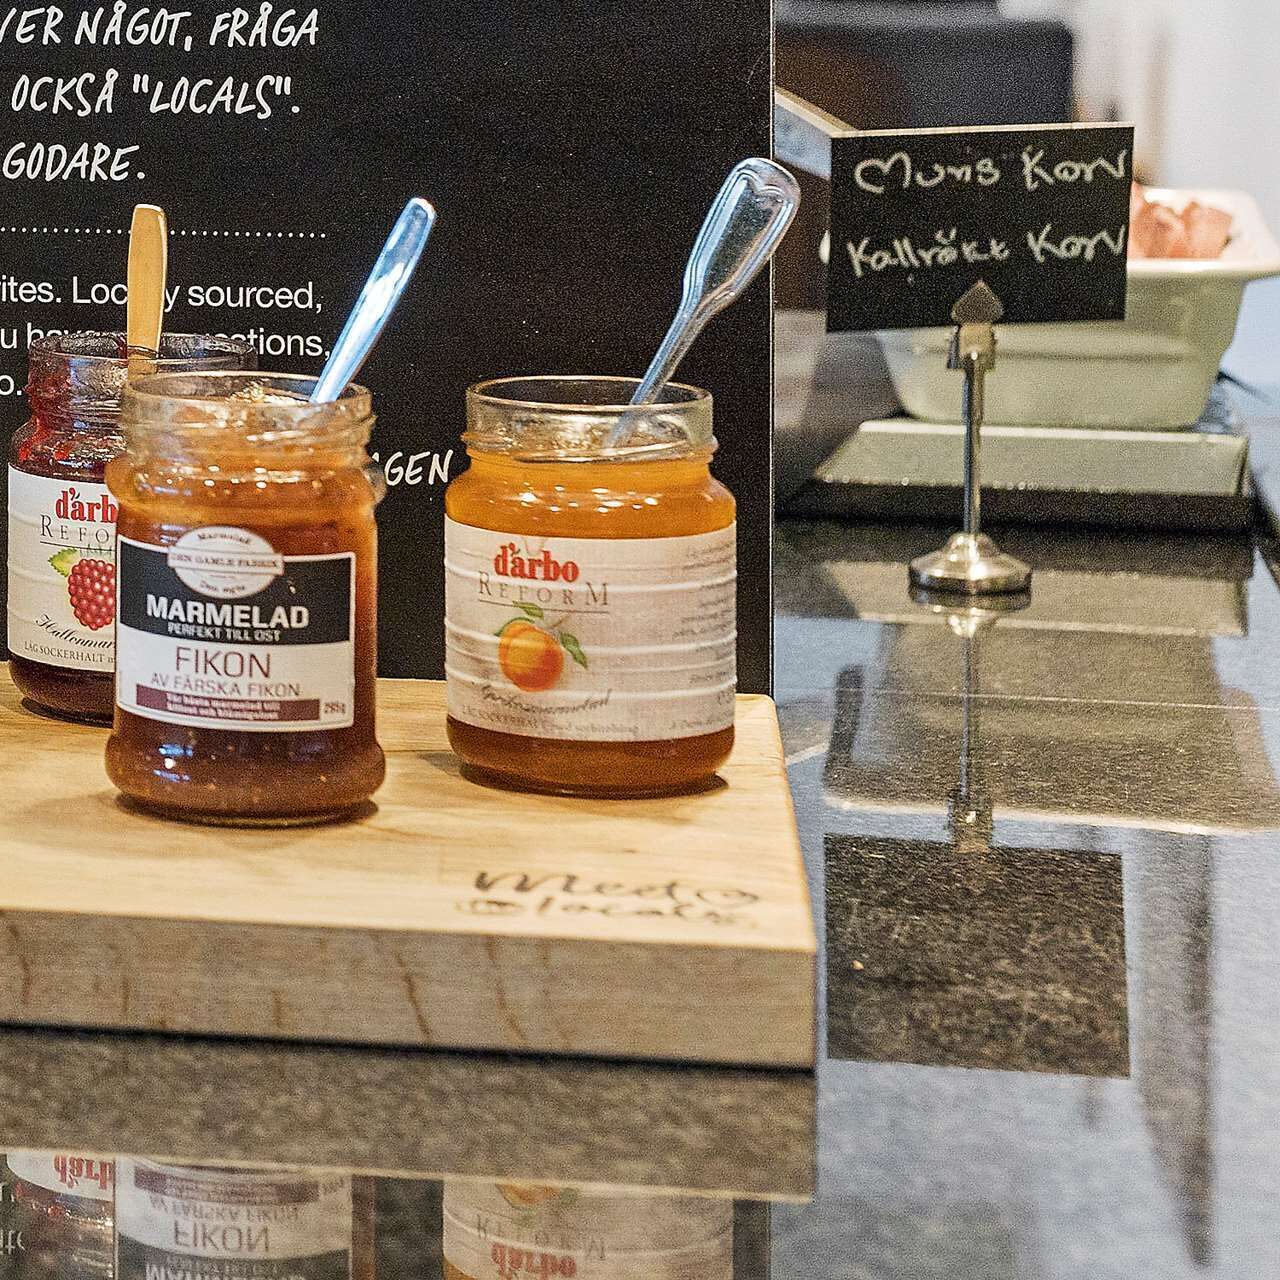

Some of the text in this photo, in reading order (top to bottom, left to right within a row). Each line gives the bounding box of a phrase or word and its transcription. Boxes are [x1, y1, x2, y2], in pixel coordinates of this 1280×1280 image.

[75, 0, 192, 51] NÅGOT,
[210, 2, 318, 47] FRÅGA
[12, 68, 118, 116] OCKSÅ
[133, 74, 299, 119] "LOCALS".
[3, 142, 145, 181] GODARE.
[72, 276, 180, 313] Locy
[188, 282, 321, 313] sourced,
[371, 449, 454, 486] GEN
[55, 487, 118, 523] d'arb
[40, 513, 111, 543] REFO
[477, 570, 609, 607] REFORM
[147, 593, 310, 630] MARMELAD
[35, 613, 115, 649] Hallonmar
[167, 622, 281, 643] PERFEKT TILL OST
[39, 644, 105, 663] SOCKERHALT
[175, 645, 272, 680] FIKON
[151, 672, 170, 686] AV
[248, 681, 301, 699] FIKON
